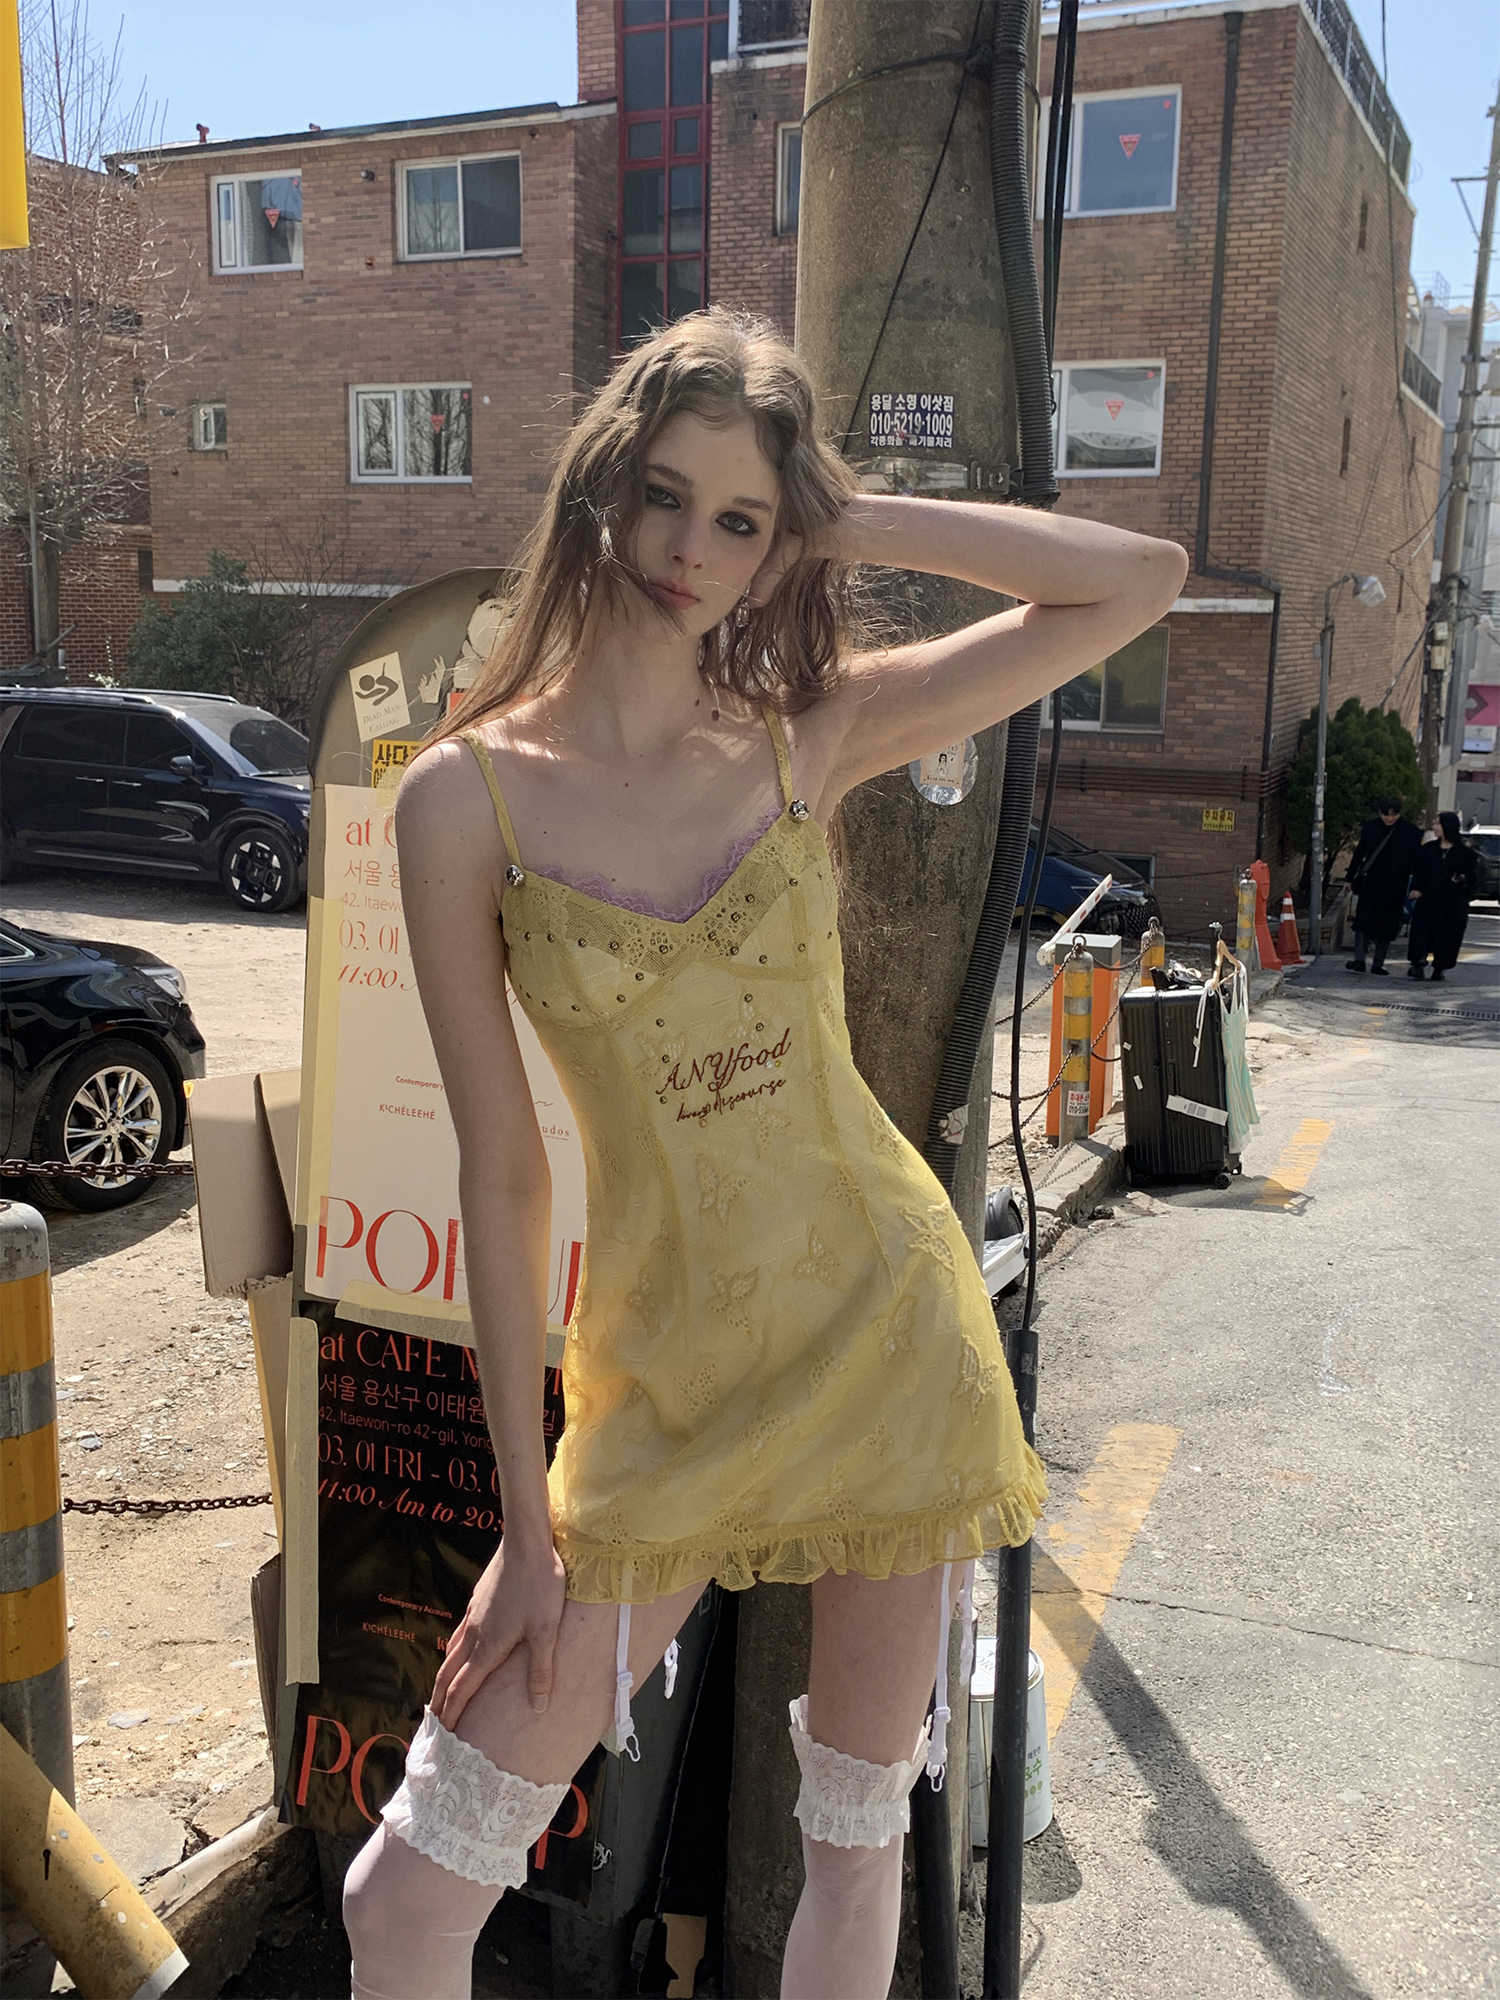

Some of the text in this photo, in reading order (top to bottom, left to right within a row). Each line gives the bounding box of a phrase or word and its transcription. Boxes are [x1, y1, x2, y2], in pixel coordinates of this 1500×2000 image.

[871, 394, 892, 411] 용달
[345, 817, 373, 848] at
[344, 859, 383, 888] 서울
[364, 895, 403, 912] Itaew
[338, 919, 370, 951] 03.
[320, 1333, 345, 1362] at
[320, 1373, 358, 1403] 서울
[362, 1379, 421, 1413] 용산구
[339, 1409, 412, 1436] Itaewon-ro
[318, 1433, 348, 1466] 03.
[355, 1439, 375, 1473] 01
[384, 1445, 424, 1482] FRI
[448, 1457, 482, 1493] 03.
[318, 1478, 504, 1532] 11:00 Am to 20:
